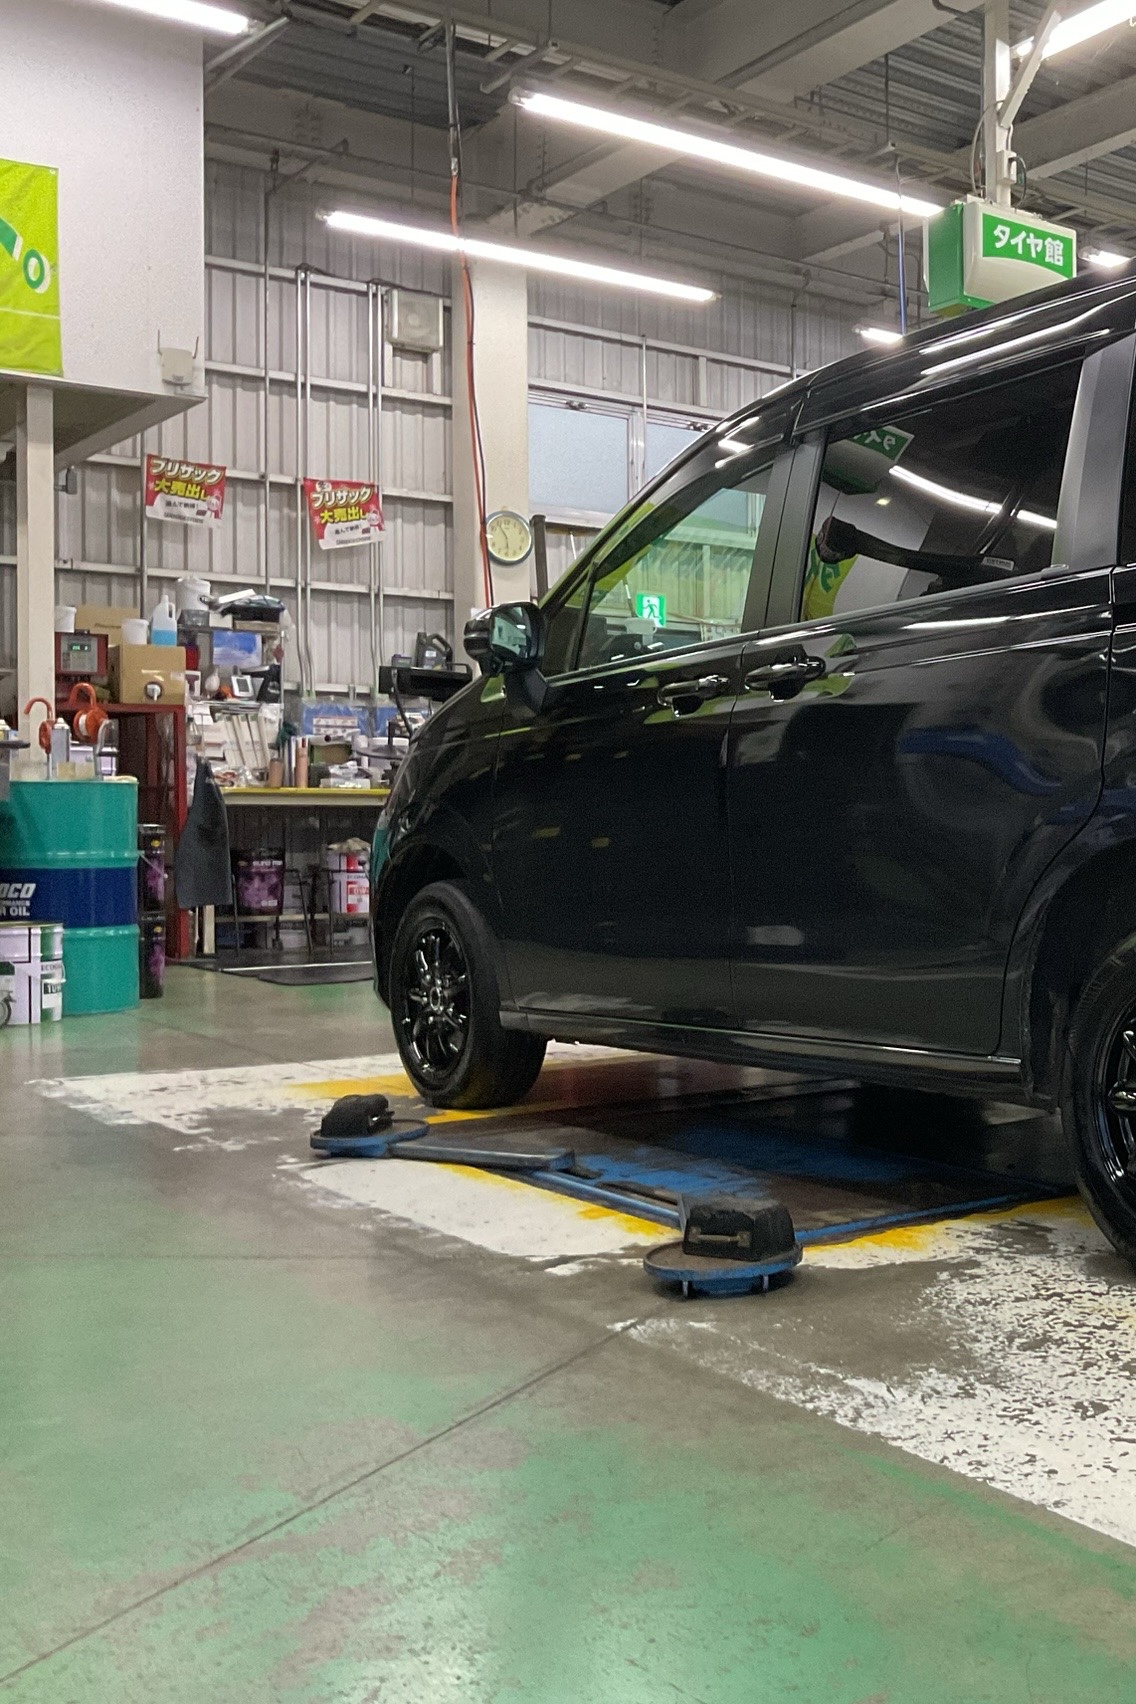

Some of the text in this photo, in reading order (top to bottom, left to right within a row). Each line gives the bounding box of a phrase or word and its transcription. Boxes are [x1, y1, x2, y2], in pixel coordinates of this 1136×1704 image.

[993, 224, 1063, 267] タイヤ館
[154, 478, 208, 501] 大売出し
[320, 506, 368, 524] 大売出し
[9, 905, 31, 917] OIL
